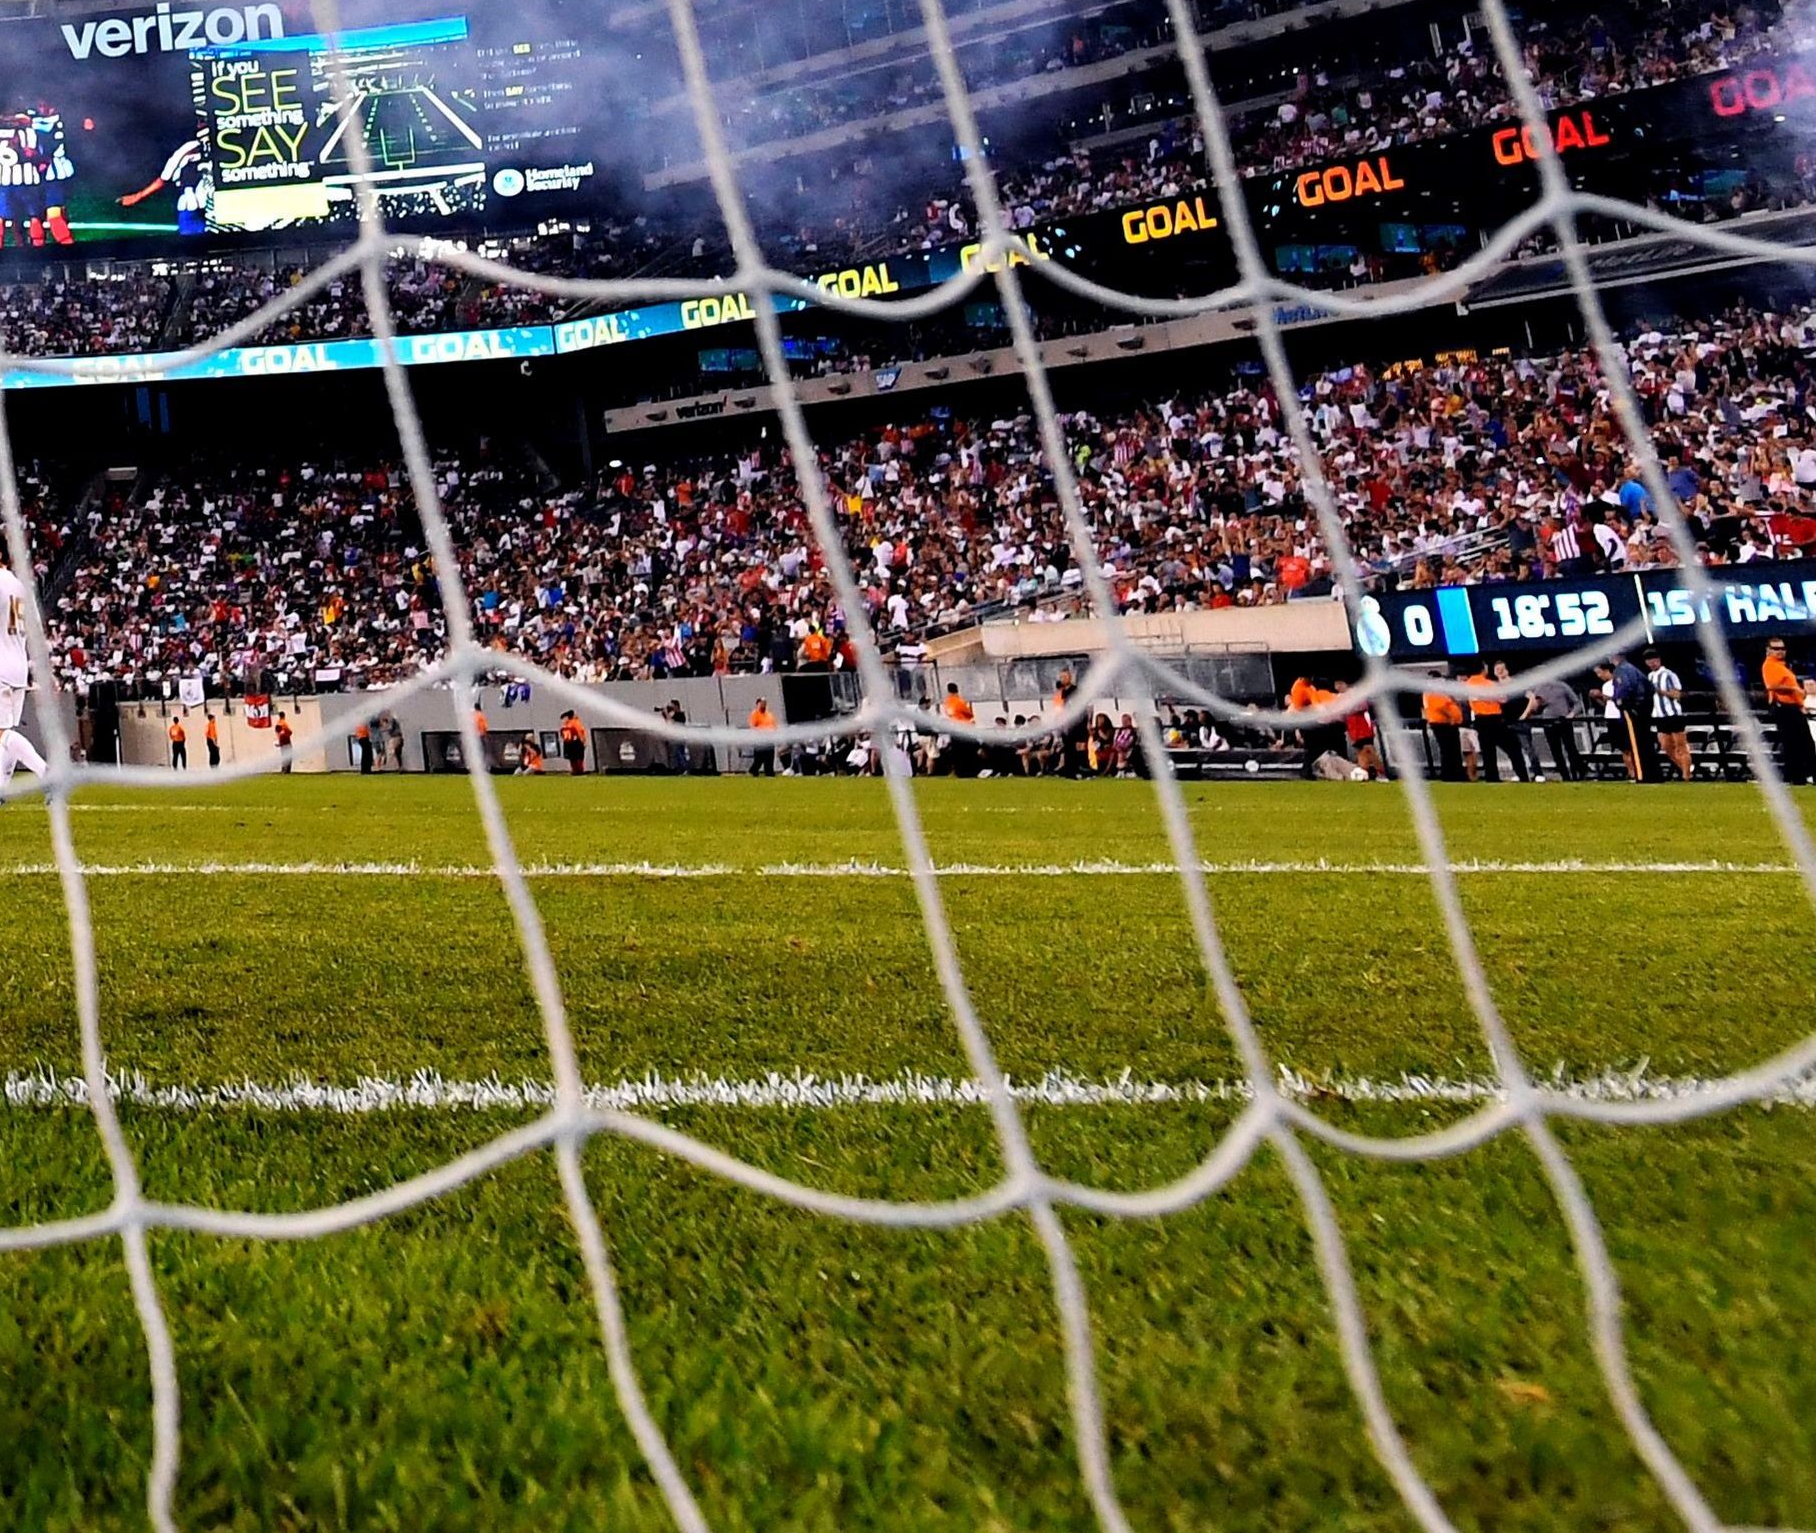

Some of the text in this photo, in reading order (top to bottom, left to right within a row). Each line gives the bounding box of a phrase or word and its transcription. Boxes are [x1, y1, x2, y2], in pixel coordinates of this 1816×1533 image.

[61, 3, 284, 60] verizon
[212, 60, 259, 80] If you
[211, 70, 302, 116] SEE
[217, 109, 305, 130] something
[216, 121, 308, 168] SAY
[1493, 111, 1610, 166] GOAL
[222, 160, 311, 183] something
[525, 162, 594, 181] Homeland
[526, 176, 580, 192] Security
[1298, 158, 1404, 207] GOAL
[1122, 197, 1217, 244] GOAL
[820, 264, 898, 300] GOAL
[680, 291, 756, 330] GOAL
[411, 330, 514, 360] GOAL
[557, 315, 626, 353] GOAL
[73, 353, 165, 382] GOAL
[242, 343, 336, 374] GOAL
[676, 400, 723, 419] verizon
[1403, 604, 1434, 646] 0
[1646, 588, 1713, 627] 1ST
